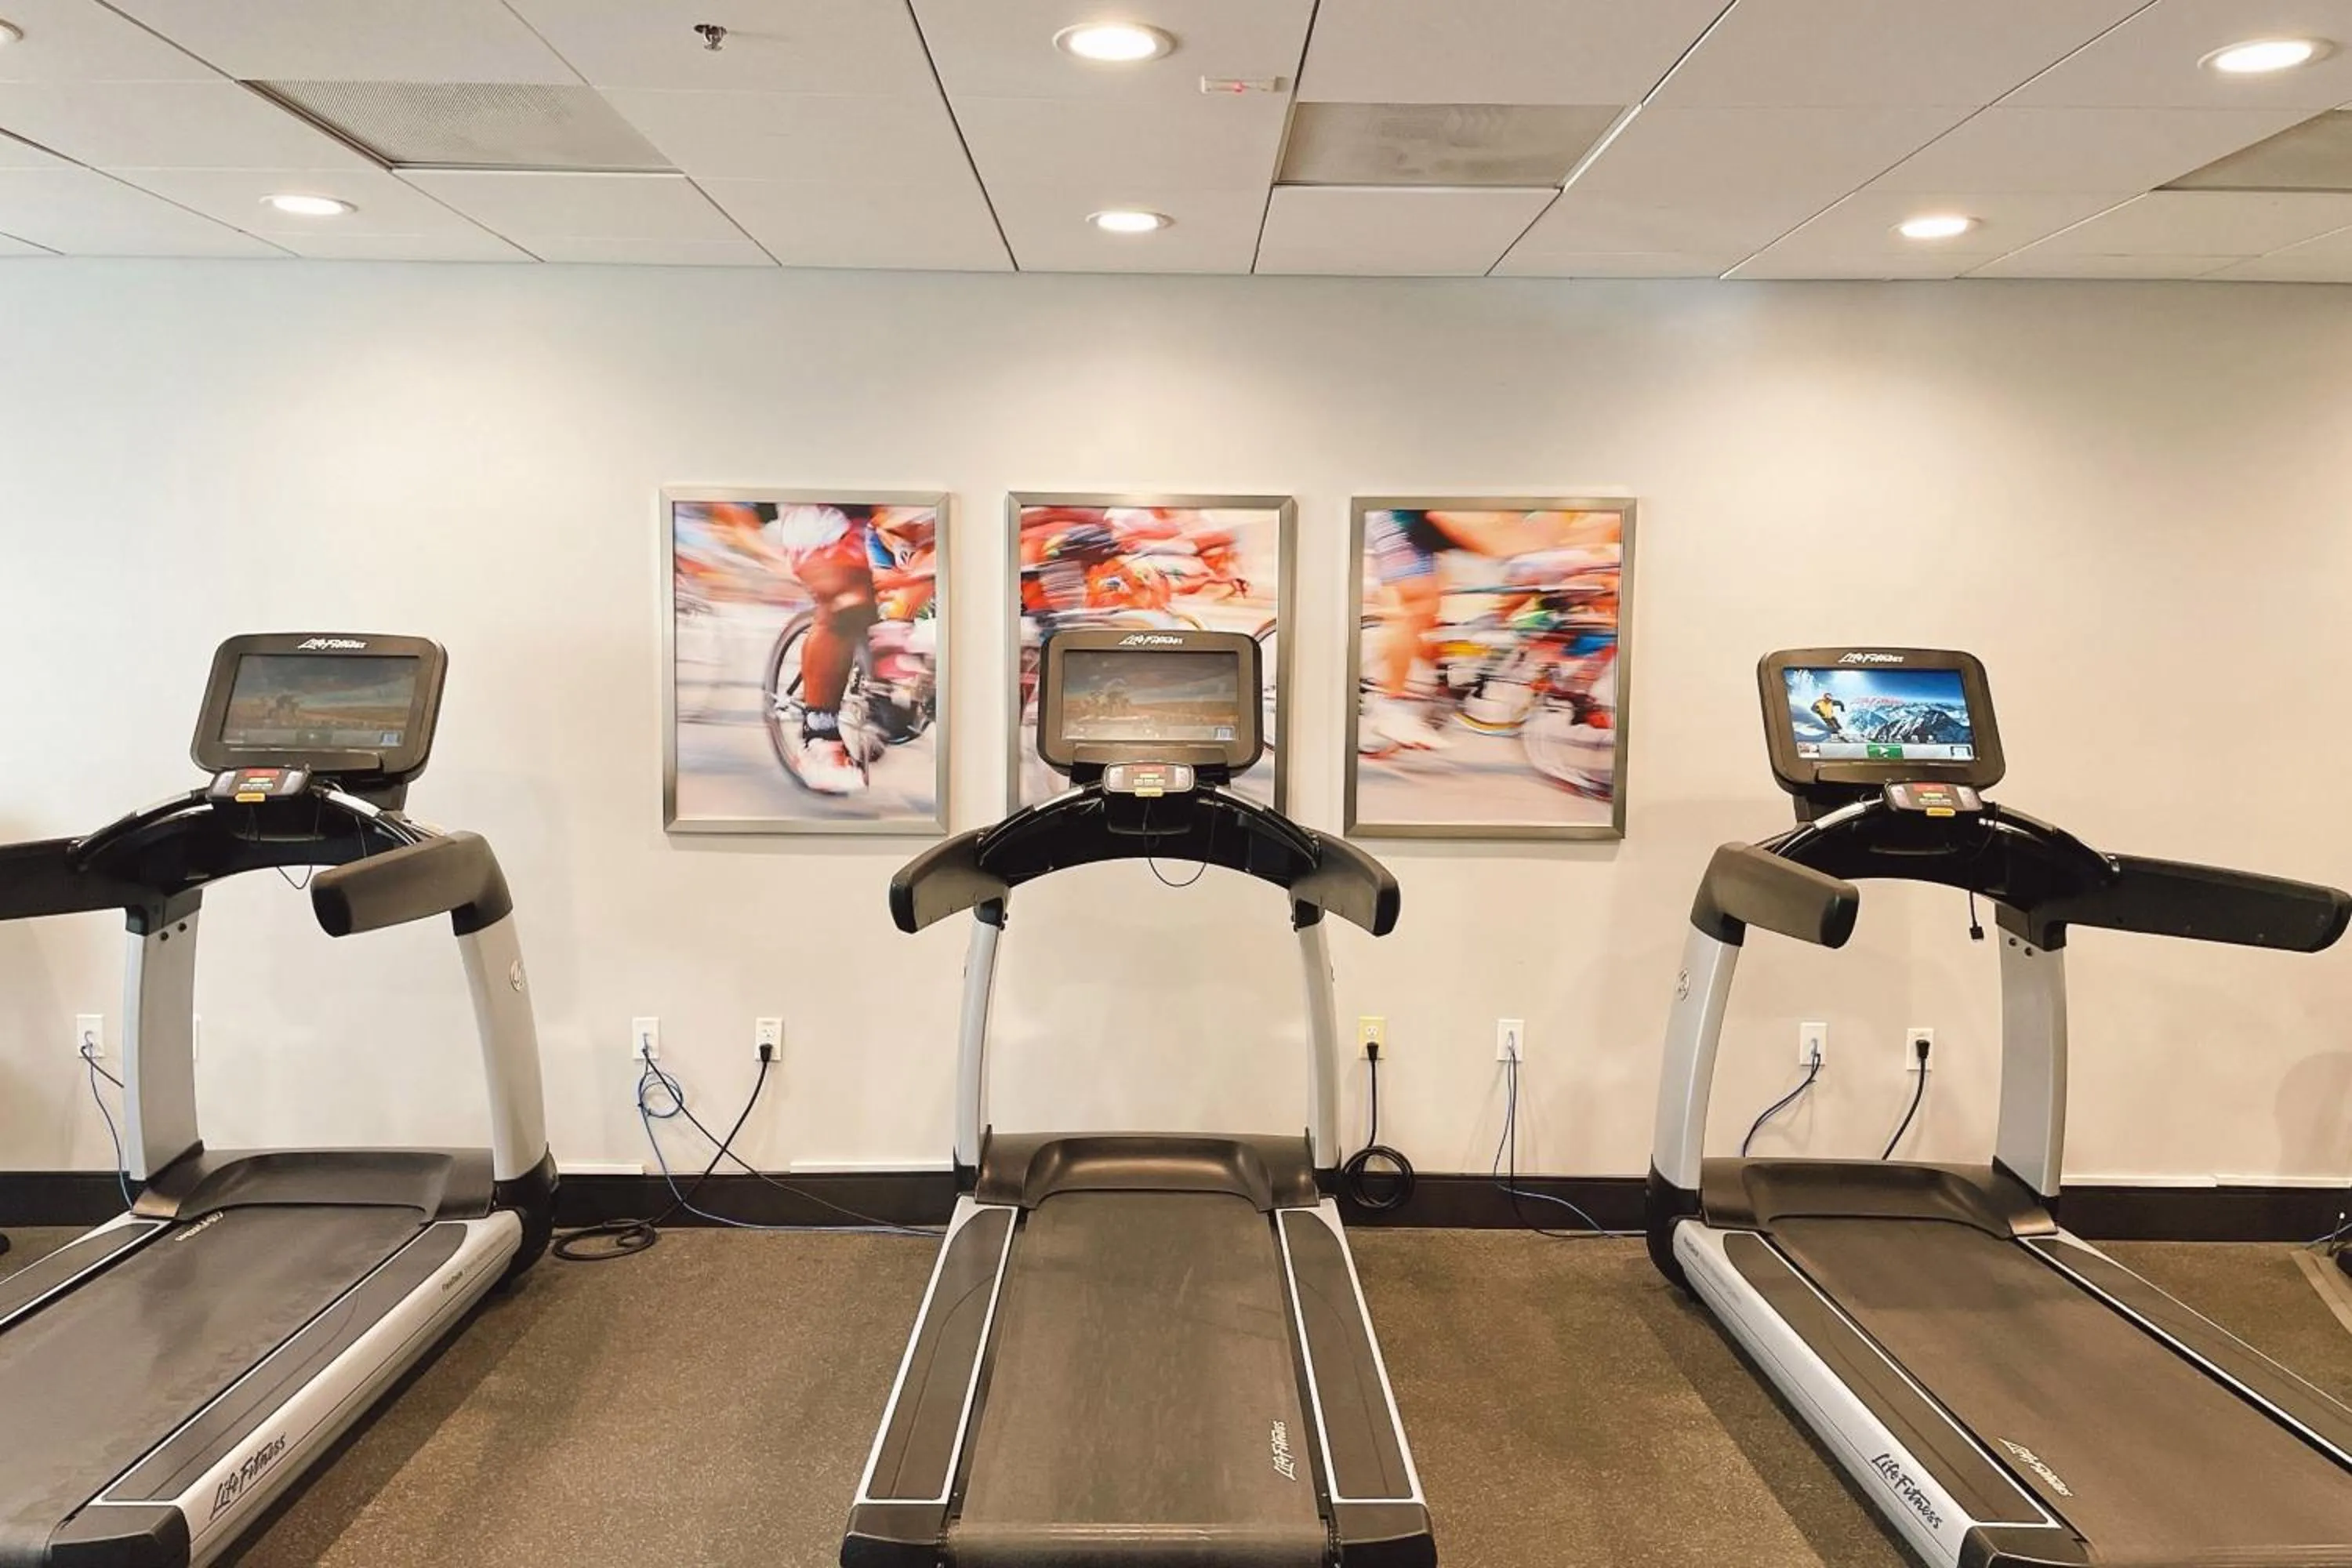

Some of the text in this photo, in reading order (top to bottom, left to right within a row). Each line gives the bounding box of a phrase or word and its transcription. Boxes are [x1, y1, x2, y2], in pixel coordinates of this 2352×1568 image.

[209, 1432, 286, 1521] Life Fitness
[1871, 1453, 1944, 1529] Life Fitness
